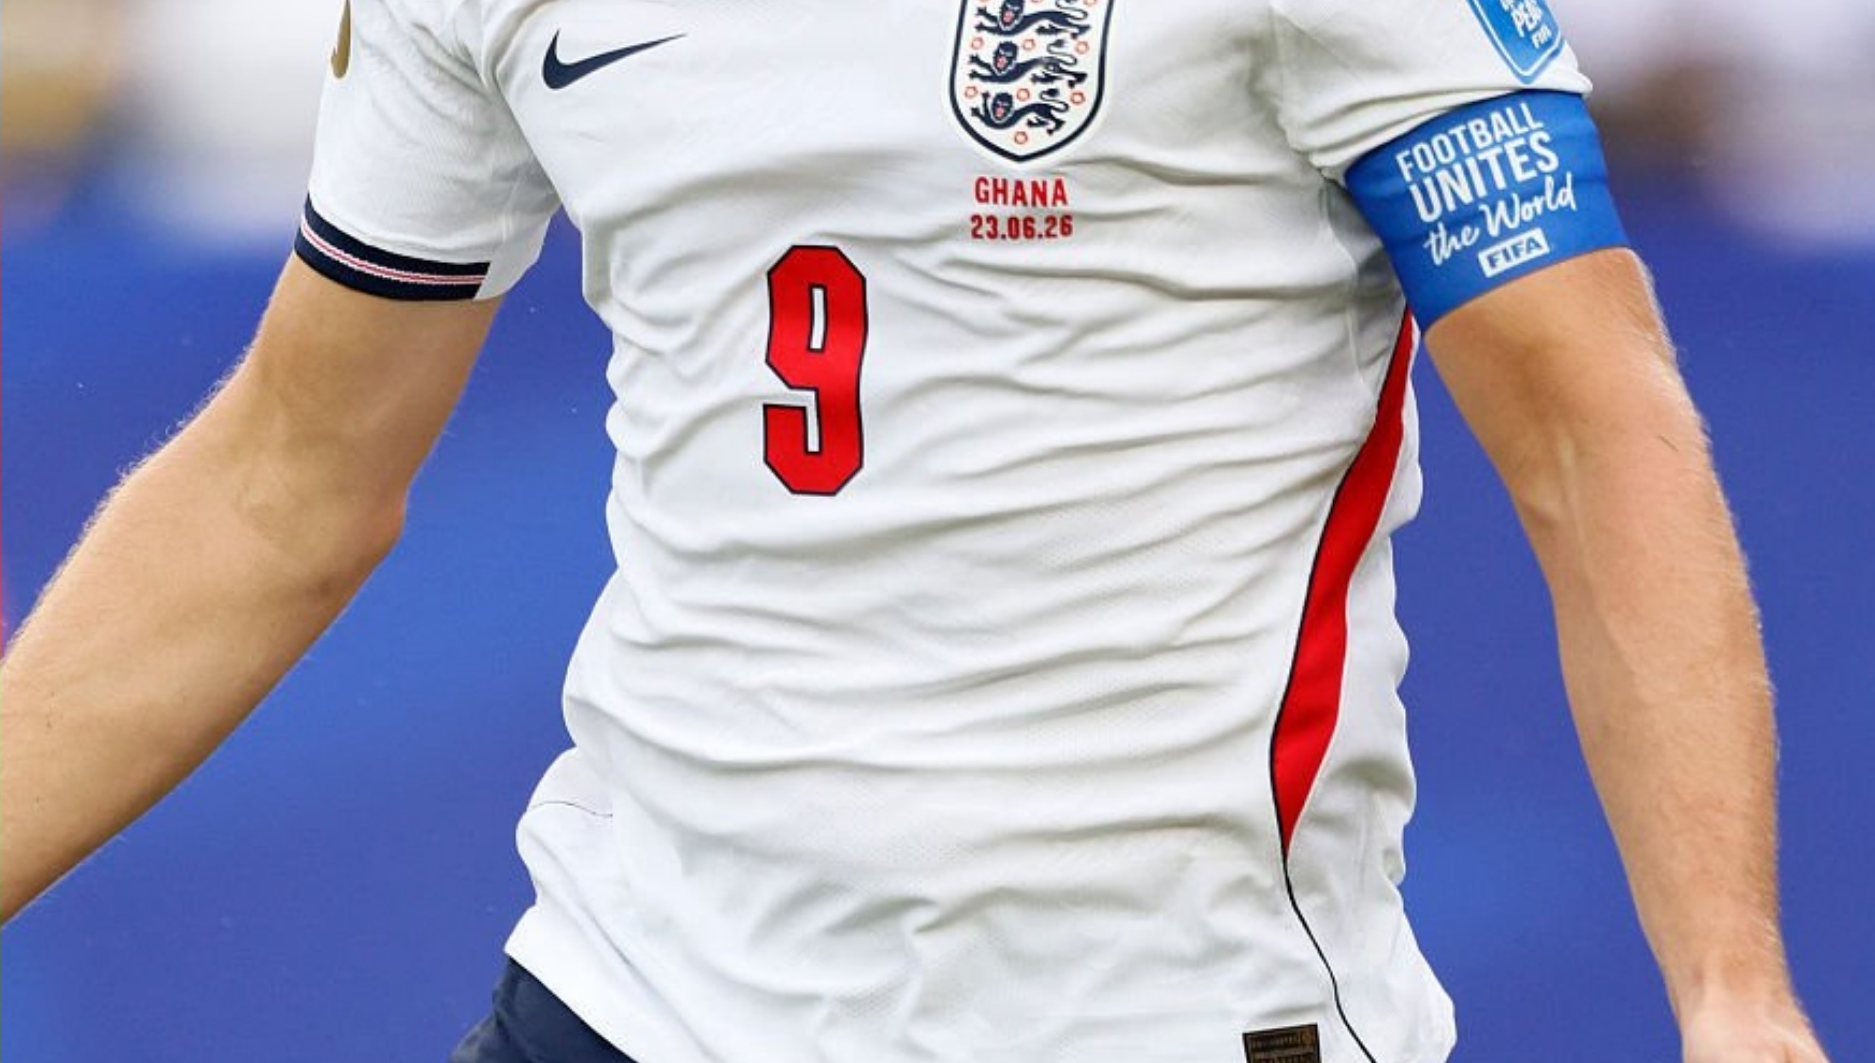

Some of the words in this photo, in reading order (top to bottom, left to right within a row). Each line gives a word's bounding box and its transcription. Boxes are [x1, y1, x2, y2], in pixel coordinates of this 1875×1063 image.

[1395, 101, 1545, 183] FOOTBALL
[1409, 130, 1559, 223] UNITES
[970, 213, 1074, 240] 23.06.26
[974, 176, 1069, 207] GHANA
[1423, 221, 1481, 266] the
[1478, 170, 1578, 237] World
[1485, 236, 1543, 271] FIFA
[763, 245, 869, 496] 9
